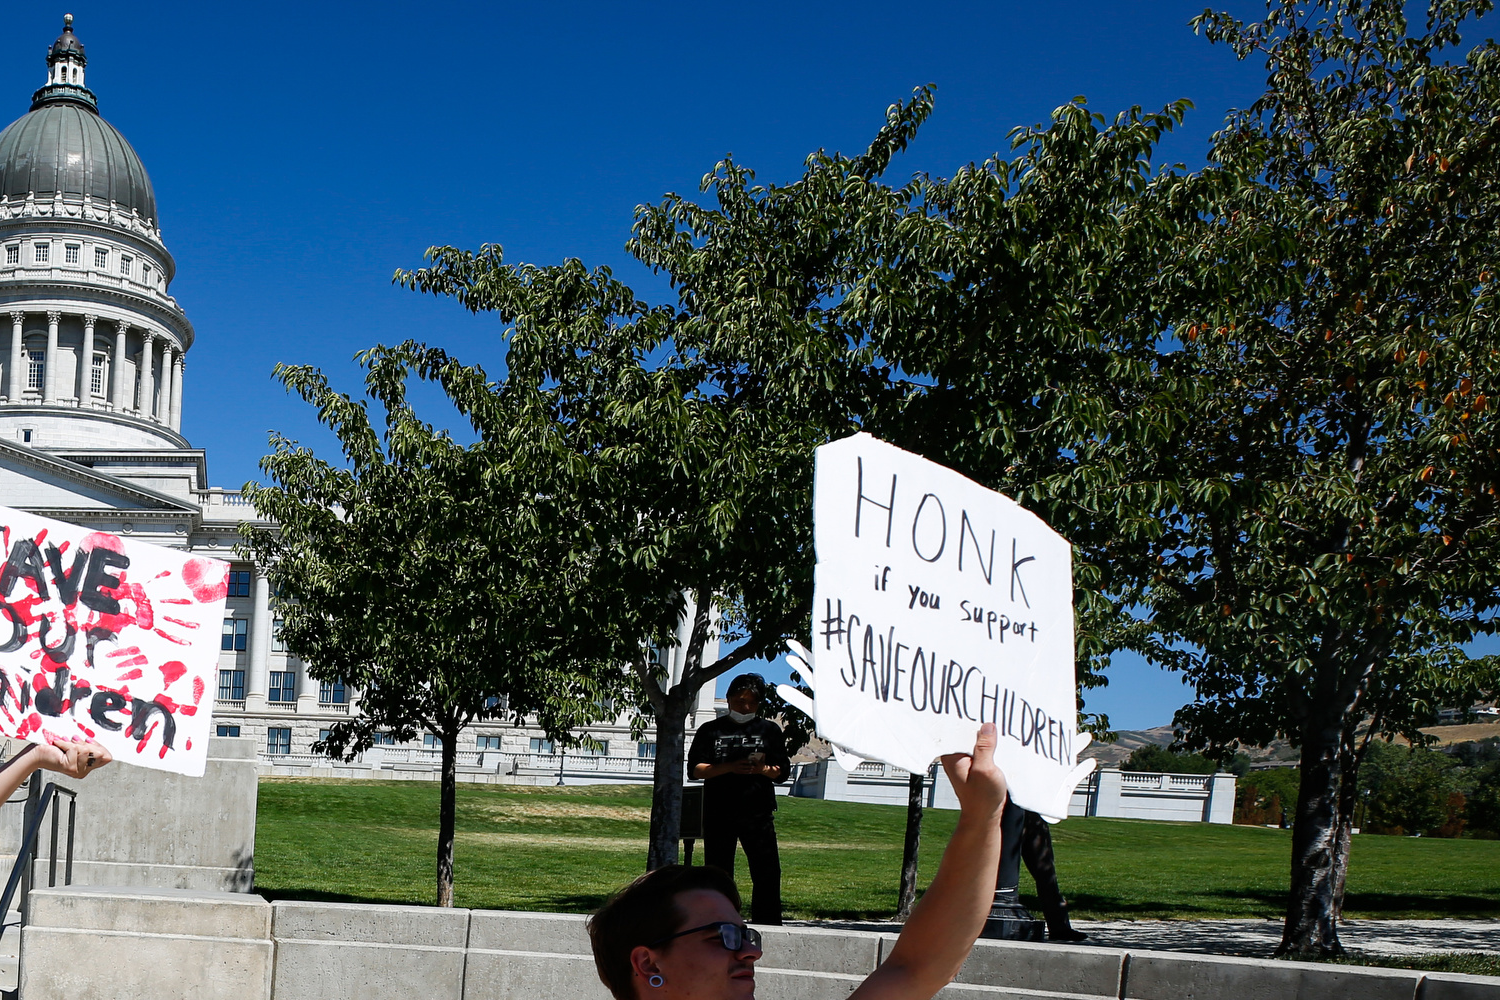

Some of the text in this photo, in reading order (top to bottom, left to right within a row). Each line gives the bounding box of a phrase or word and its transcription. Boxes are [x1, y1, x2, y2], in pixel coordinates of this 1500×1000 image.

[855, 456, 1036, 609] HONK
[874, 565, 891, 591] if
[908, 584, 940, 609] you
[820, 598, 1073, 766] #SAVEOURCHILDREN
